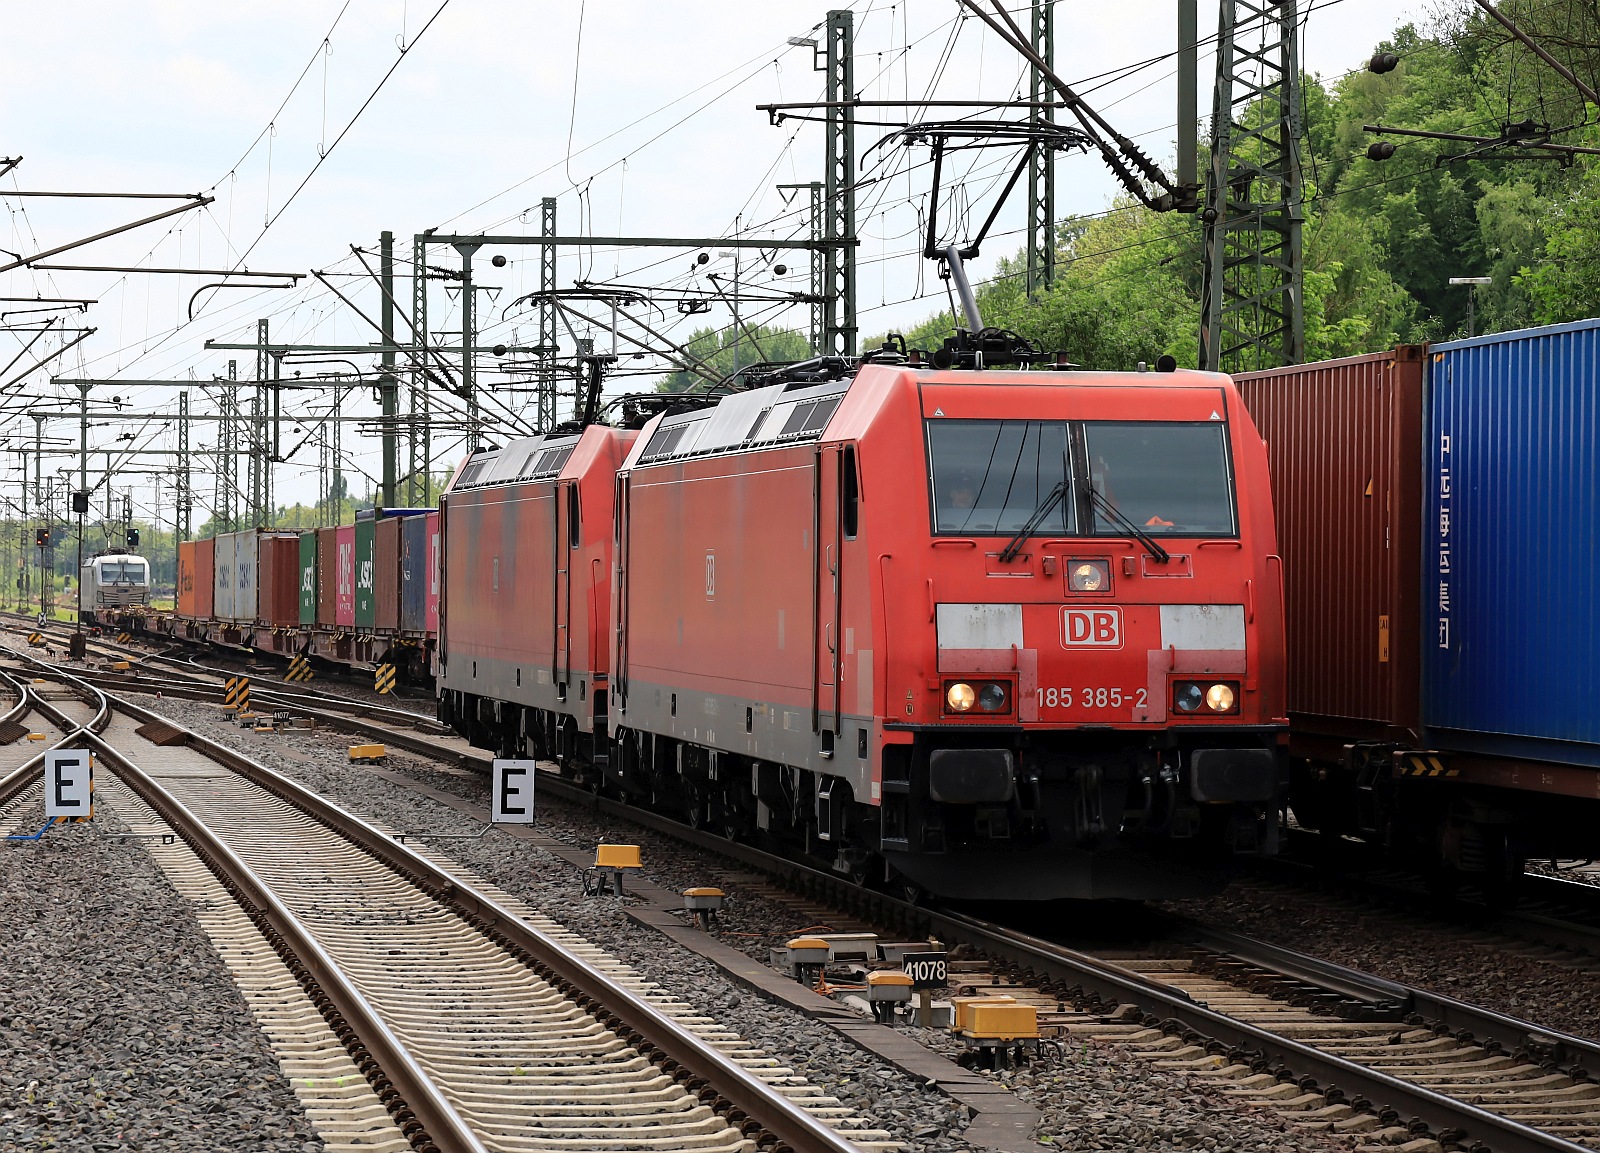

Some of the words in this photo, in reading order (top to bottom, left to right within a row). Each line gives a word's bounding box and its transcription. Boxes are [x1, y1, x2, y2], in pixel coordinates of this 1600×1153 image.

[1068, 612, 1116, 642] DB
[1036, 687, 1073, 708] 185
[1081, 687, 1148, 708] 385-2
[54, 759, 80, 806] E
[501, 768, 527, 815] E
[904, 960, 946, 981] 41078
